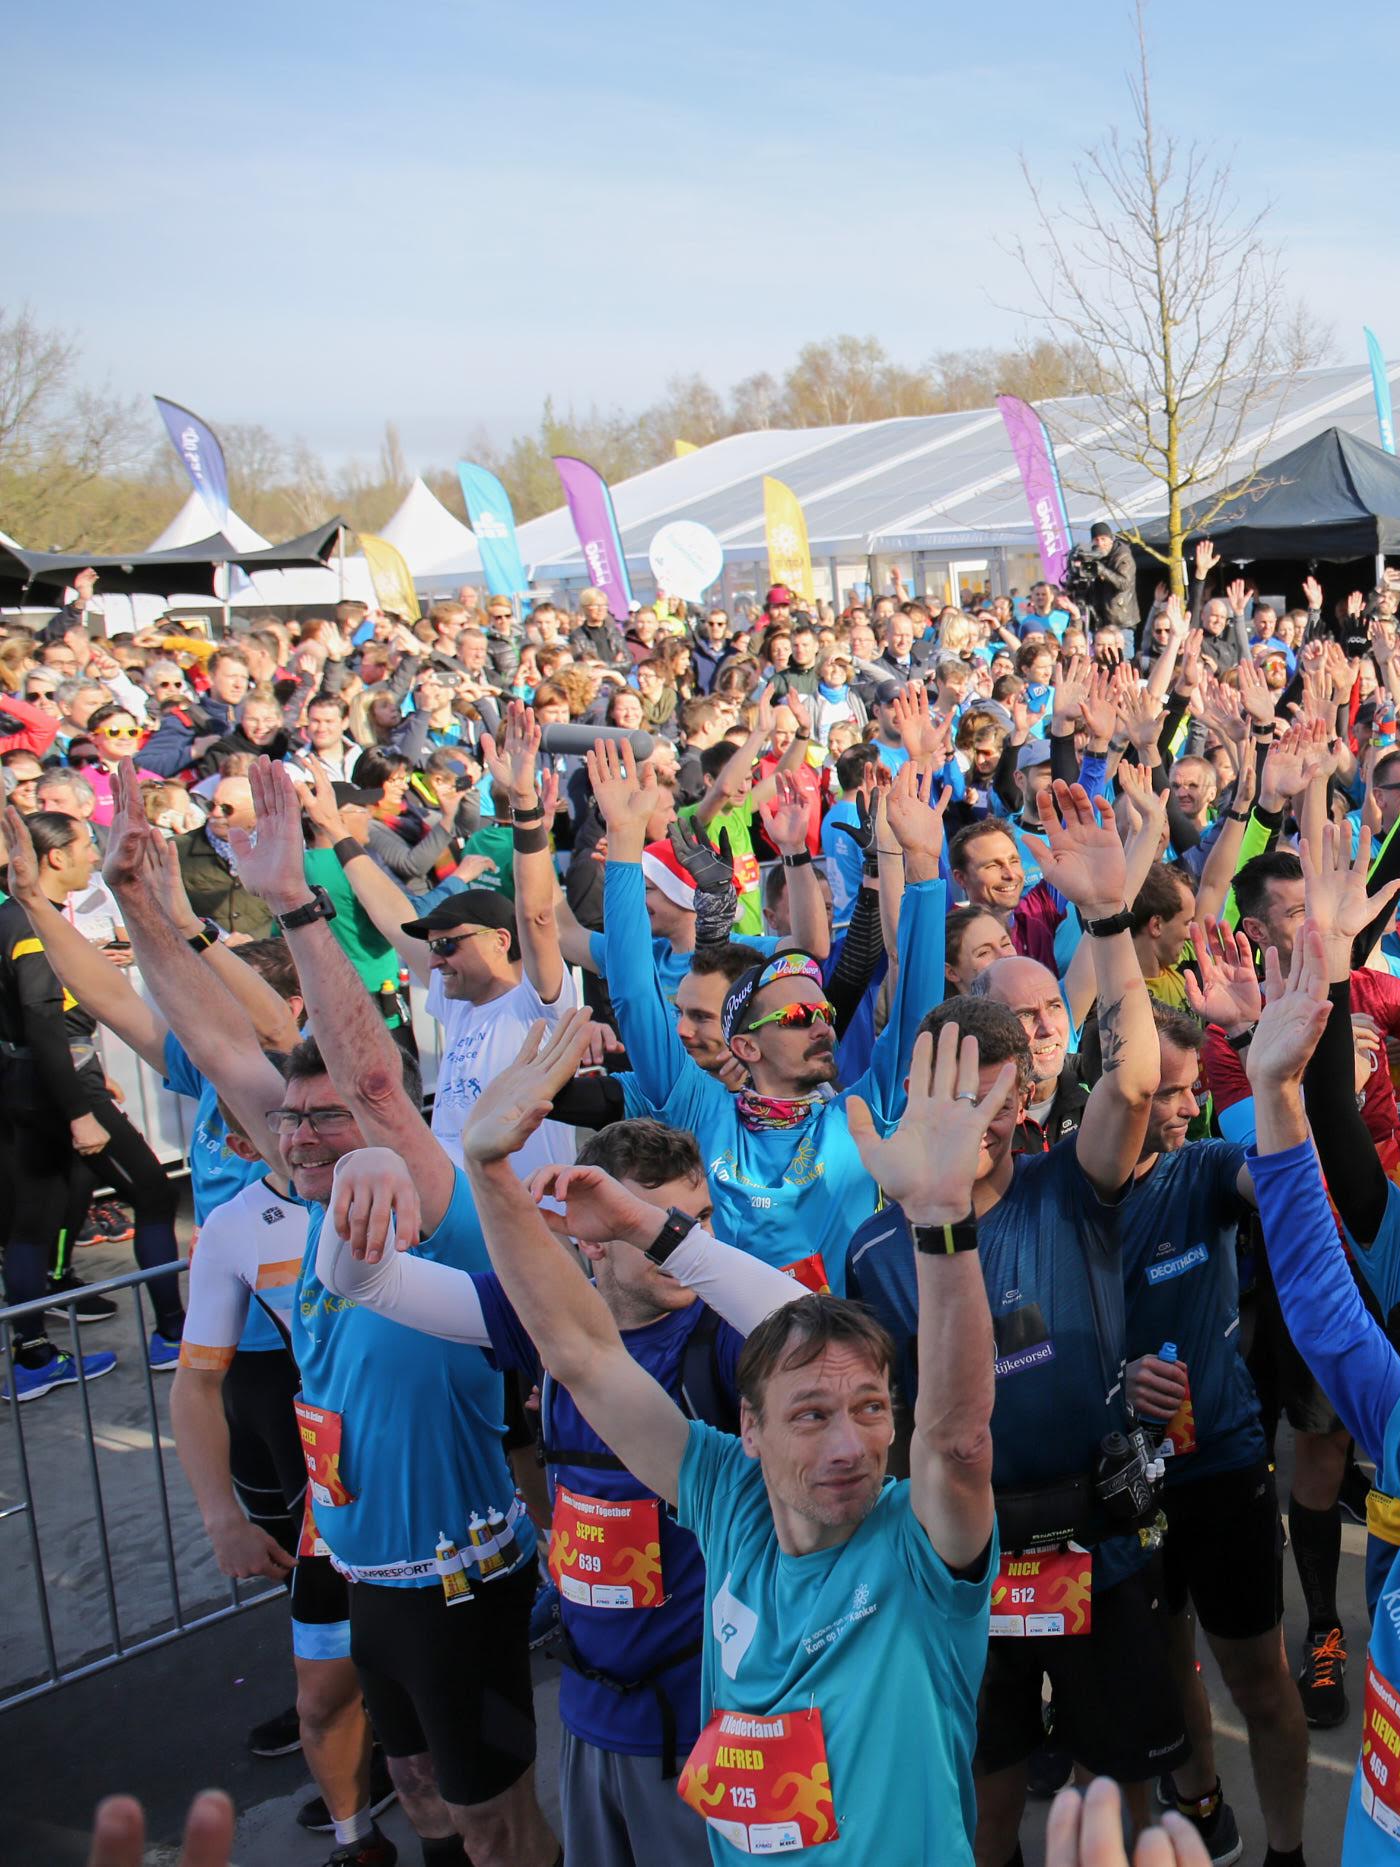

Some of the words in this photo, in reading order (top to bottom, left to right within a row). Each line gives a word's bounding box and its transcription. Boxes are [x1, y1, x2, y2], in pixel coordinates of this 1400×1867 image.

[751, 1196, 771, 1209] 2019
[595, 1504, 632, 1518] Together
[576, 1521, 605, 1543] SEPPE
[579, 1553, 601, 1573] 639
[1007, 1561, 1041, 1576] NICK
[1011, 1587, 1035, 1603] 512
[804, 1636, 827, 1655] Kom
[826, 1629, 838, 1644] op
[715, 1745, 765, 1771] ALFRED
[1369, 1751, 1388, 1787] 469
[729, 1786, 757, 1809] 125
